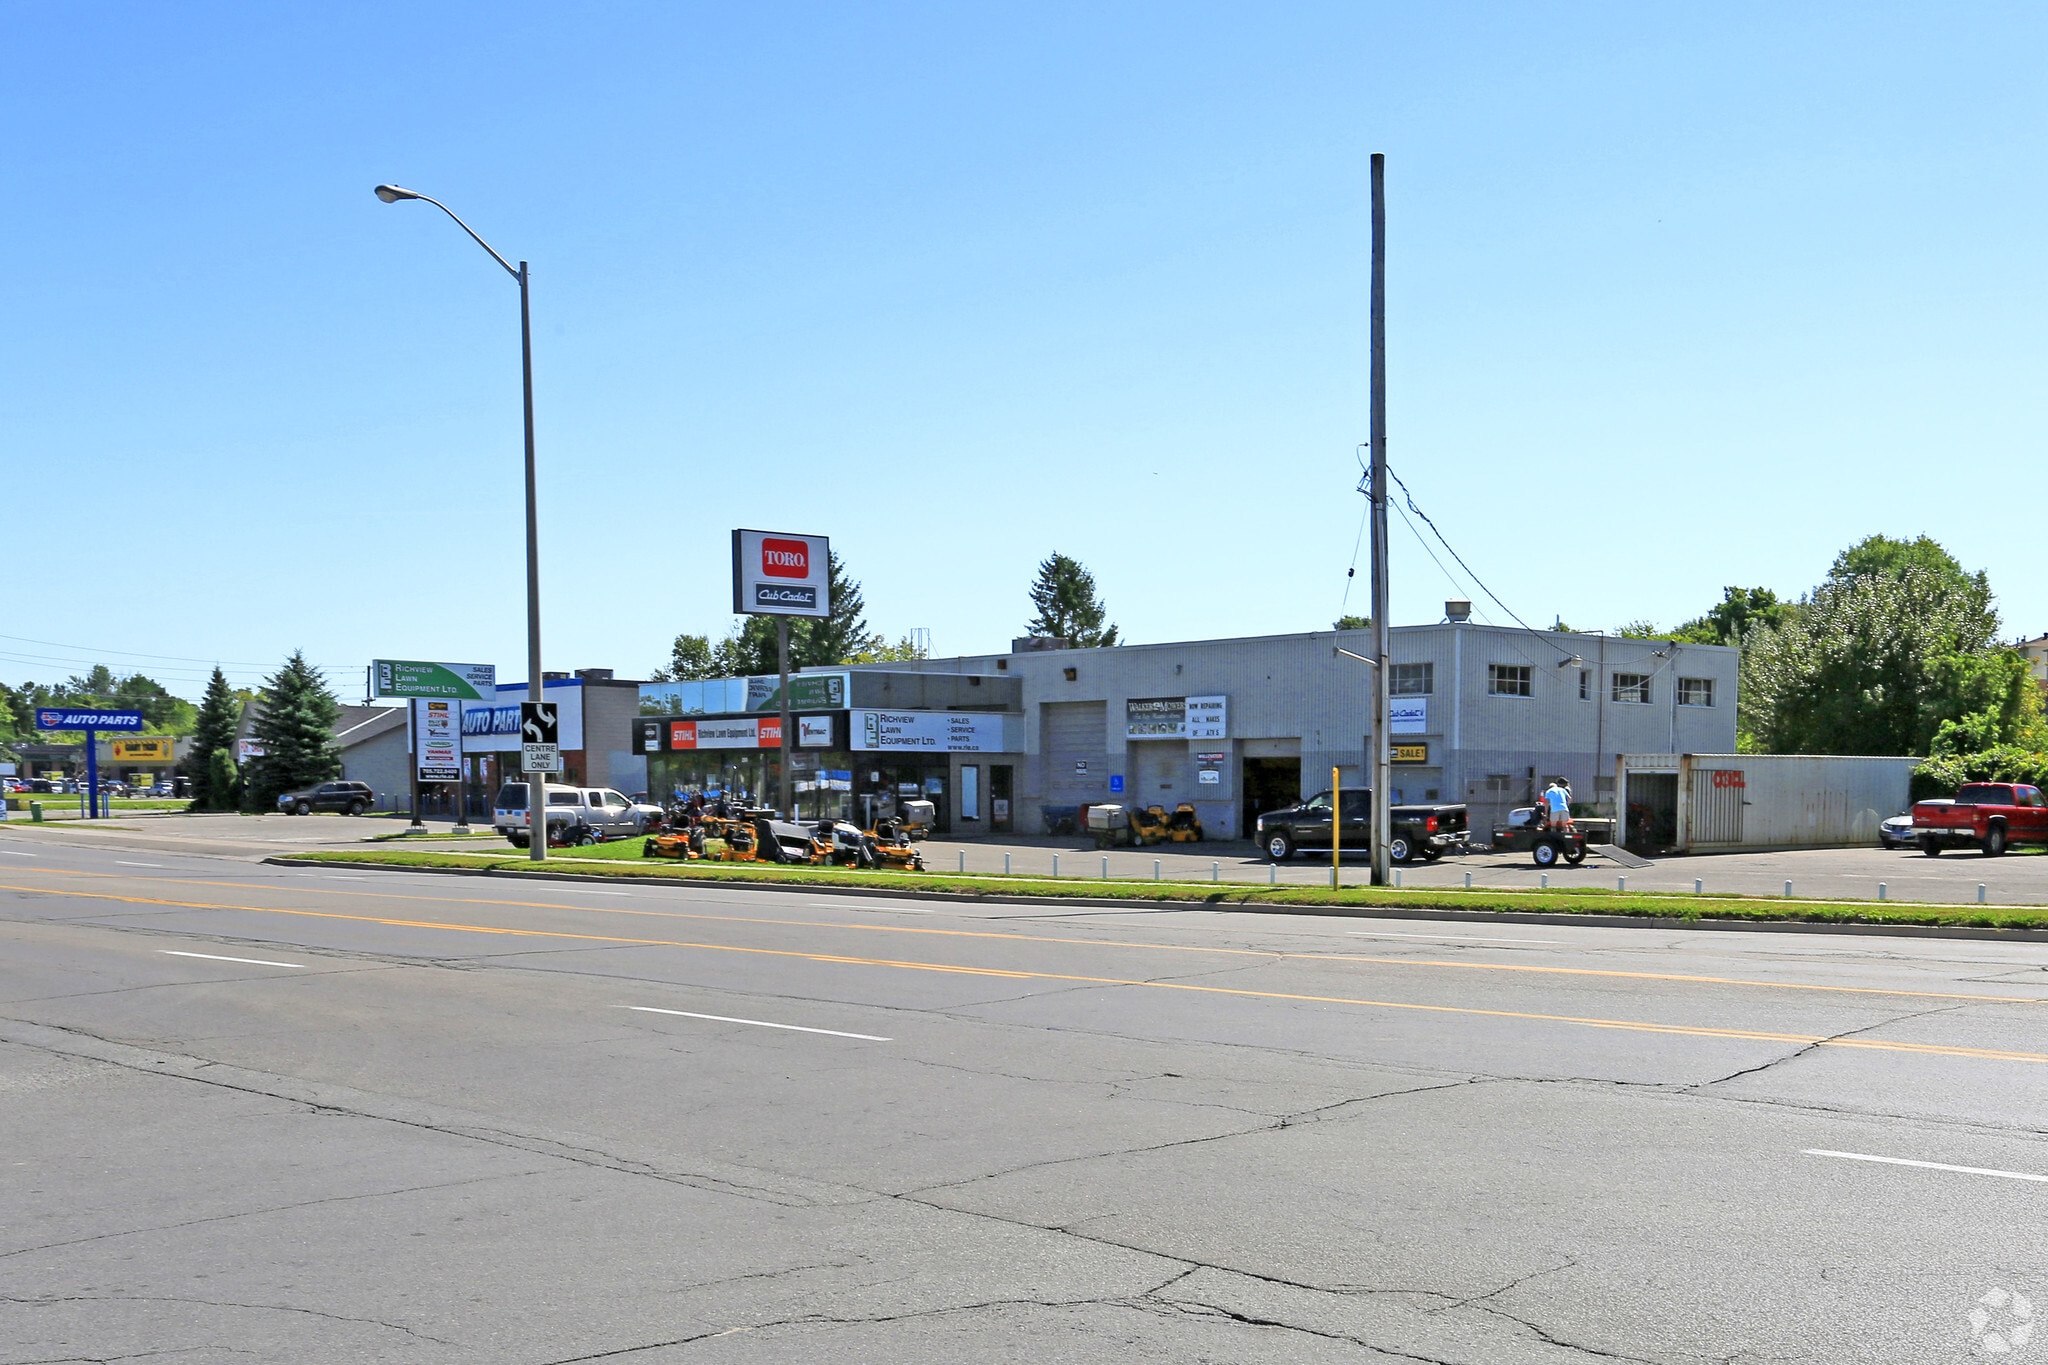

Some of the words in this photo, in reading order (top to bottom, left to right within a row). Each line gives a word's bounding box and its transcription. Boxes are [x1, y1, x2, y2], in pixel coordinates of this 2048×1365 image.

[759, 590, 779, 600] Cub
[780, 591, 813, 602] Cadet
[63, 715, 97, 724] AUTO
[98, 715, 138, 725] PARTS
[462, 711, 490, 733] AUTO
[492, 709, 521, 731] PART
[673, 730, 694, 740] STIHL
[1400, 748, 1424, 758] SALE!
